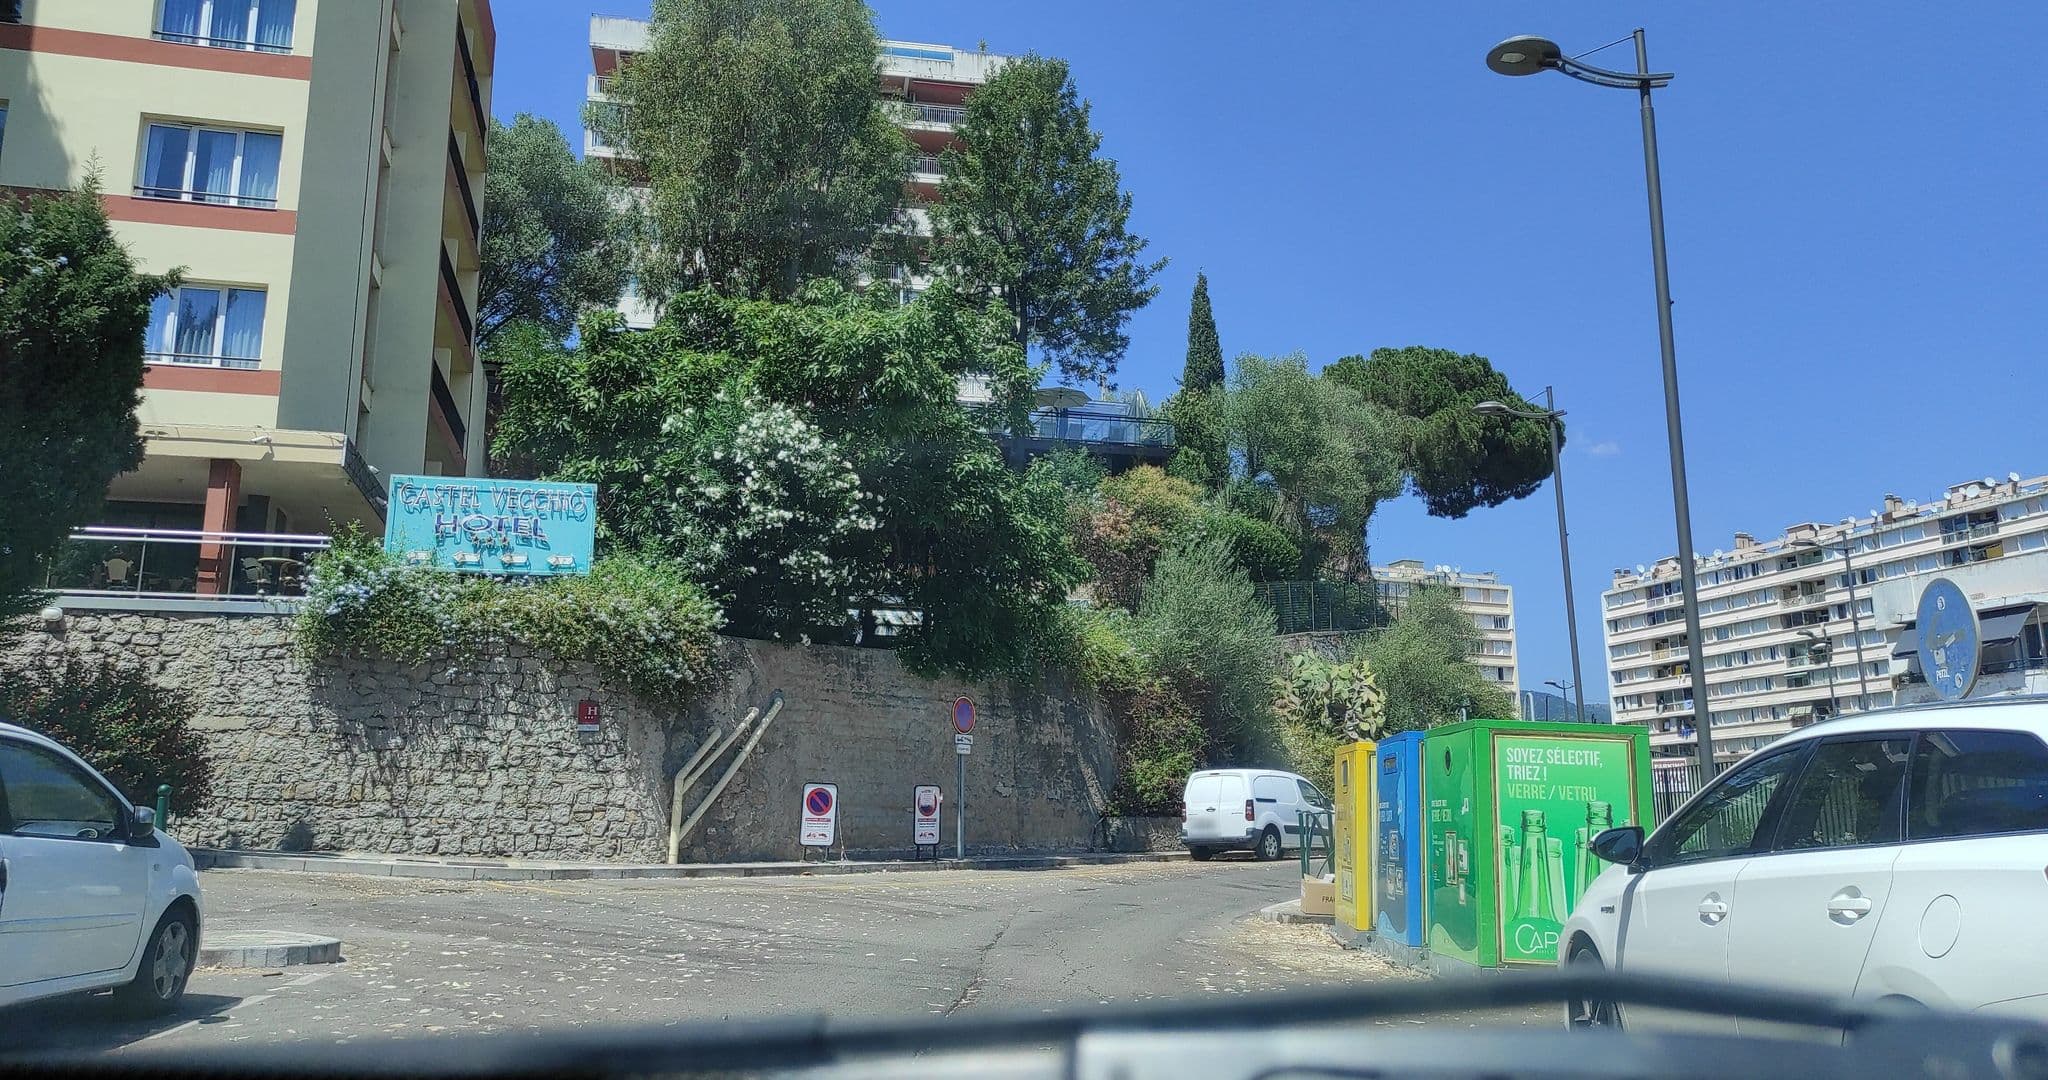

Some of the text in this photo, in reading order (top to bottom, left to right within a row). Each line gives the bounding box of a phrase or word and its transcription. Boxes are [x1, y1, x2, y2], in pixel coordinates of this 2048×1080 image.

[399, 483, 587, 513] CASTEL VECCHIO
[435, 514, 548, 539] HOTEL
[588, 706, 598, 715] H
[1506, 746, 1603, 768] SOYEZ SÉLECTIF,
[1506, 765, 1547, 781] TRIEZ !
[1507, 783, 1597, 802] VERRE / VETRU
